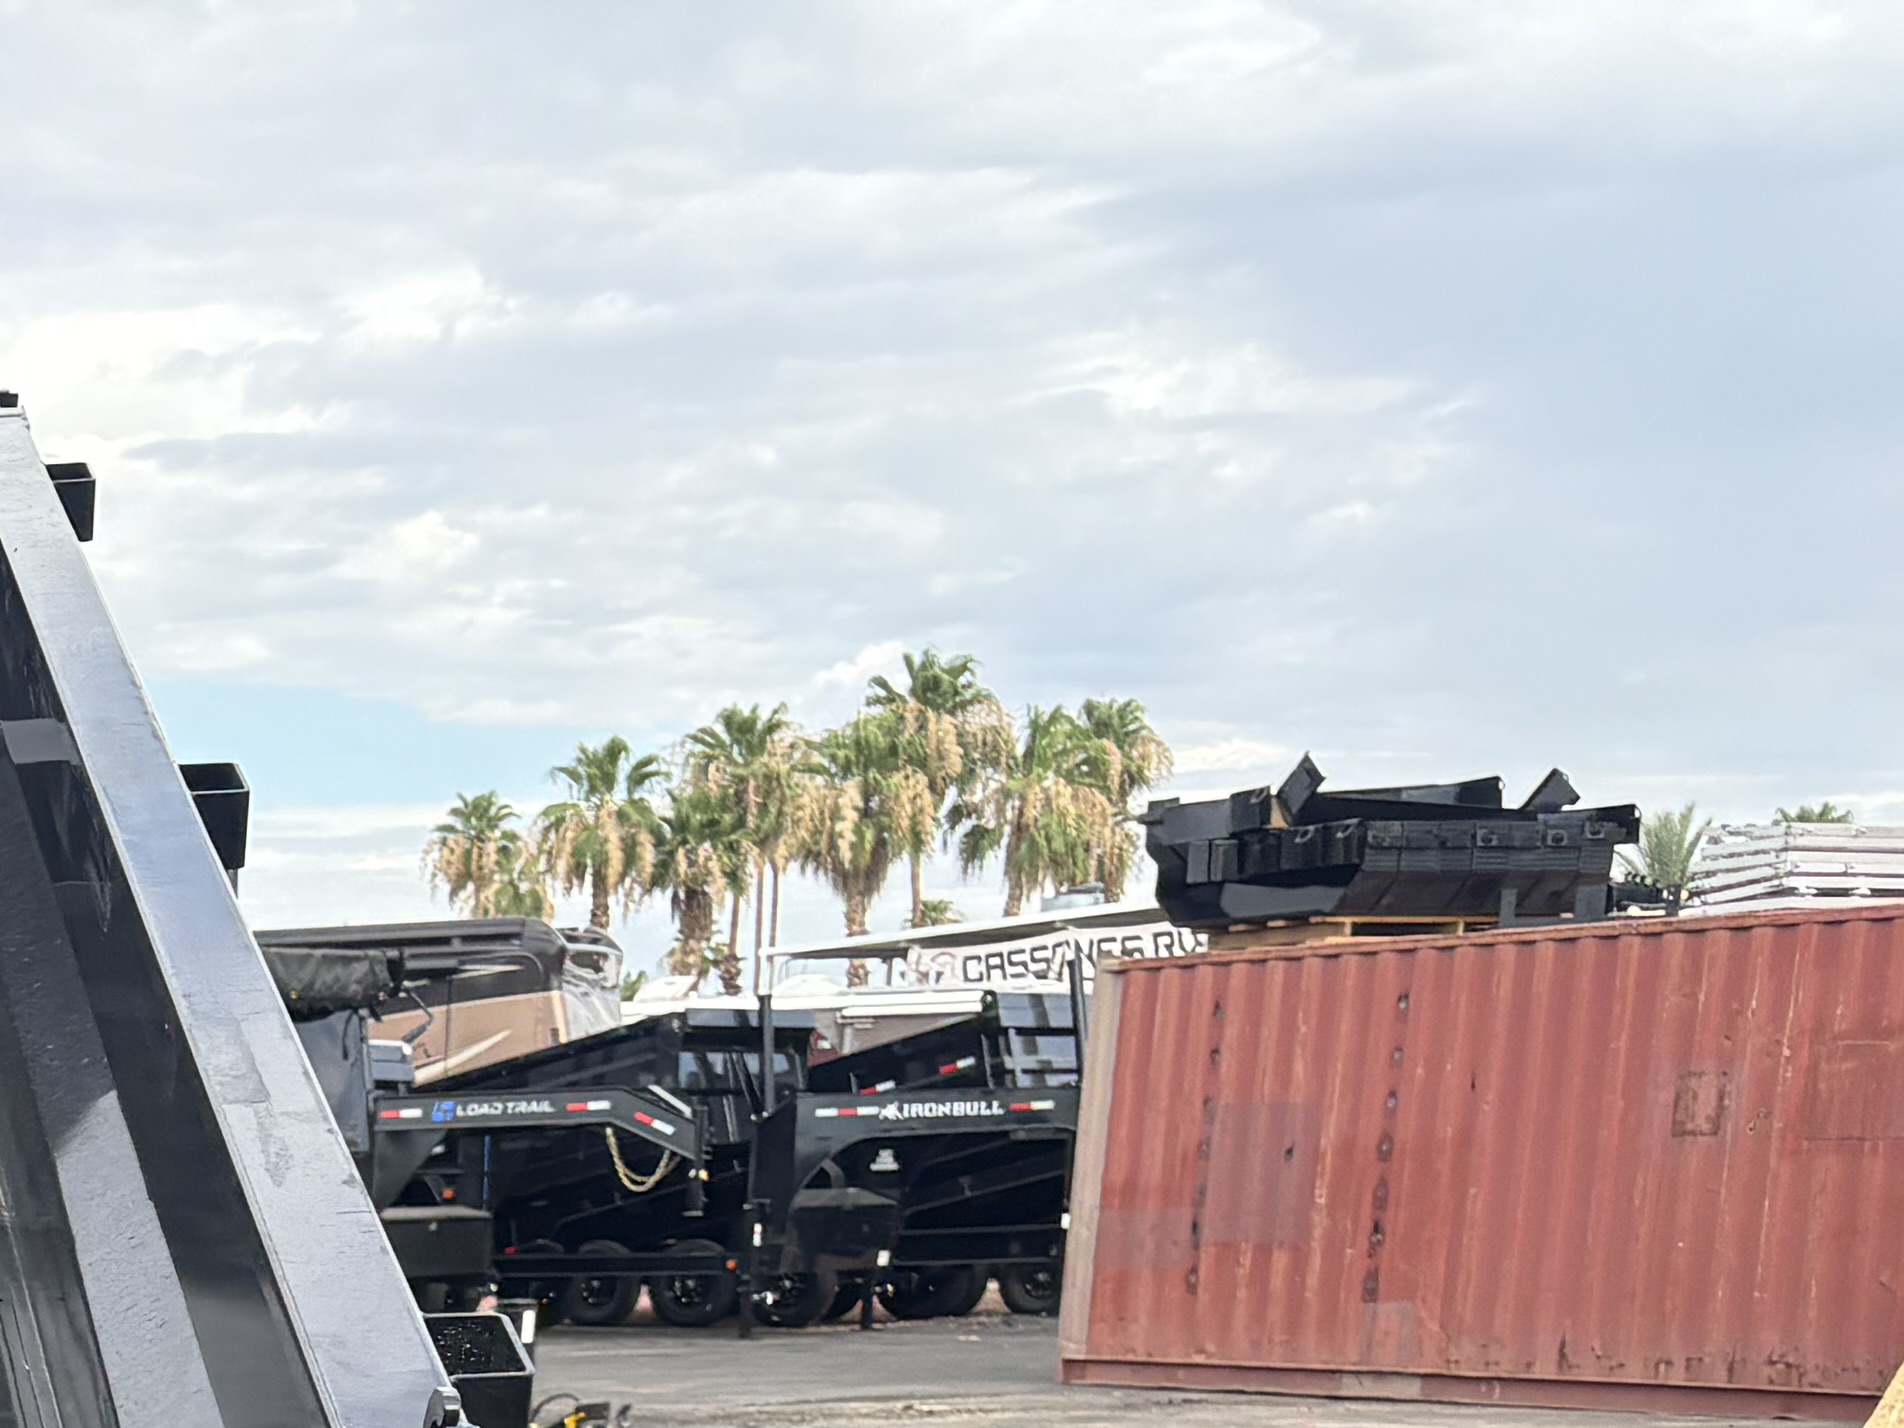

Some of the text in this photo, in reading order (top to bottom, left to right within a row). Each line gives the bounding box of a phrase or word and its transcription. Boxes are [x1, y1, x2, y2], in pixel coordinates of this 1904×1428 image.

[456, 1101, 503, 1117] LOAD
[506, 1099, 556, 1115] TRAIL
[903, 1100, 1005, 1118] IRONBULL
